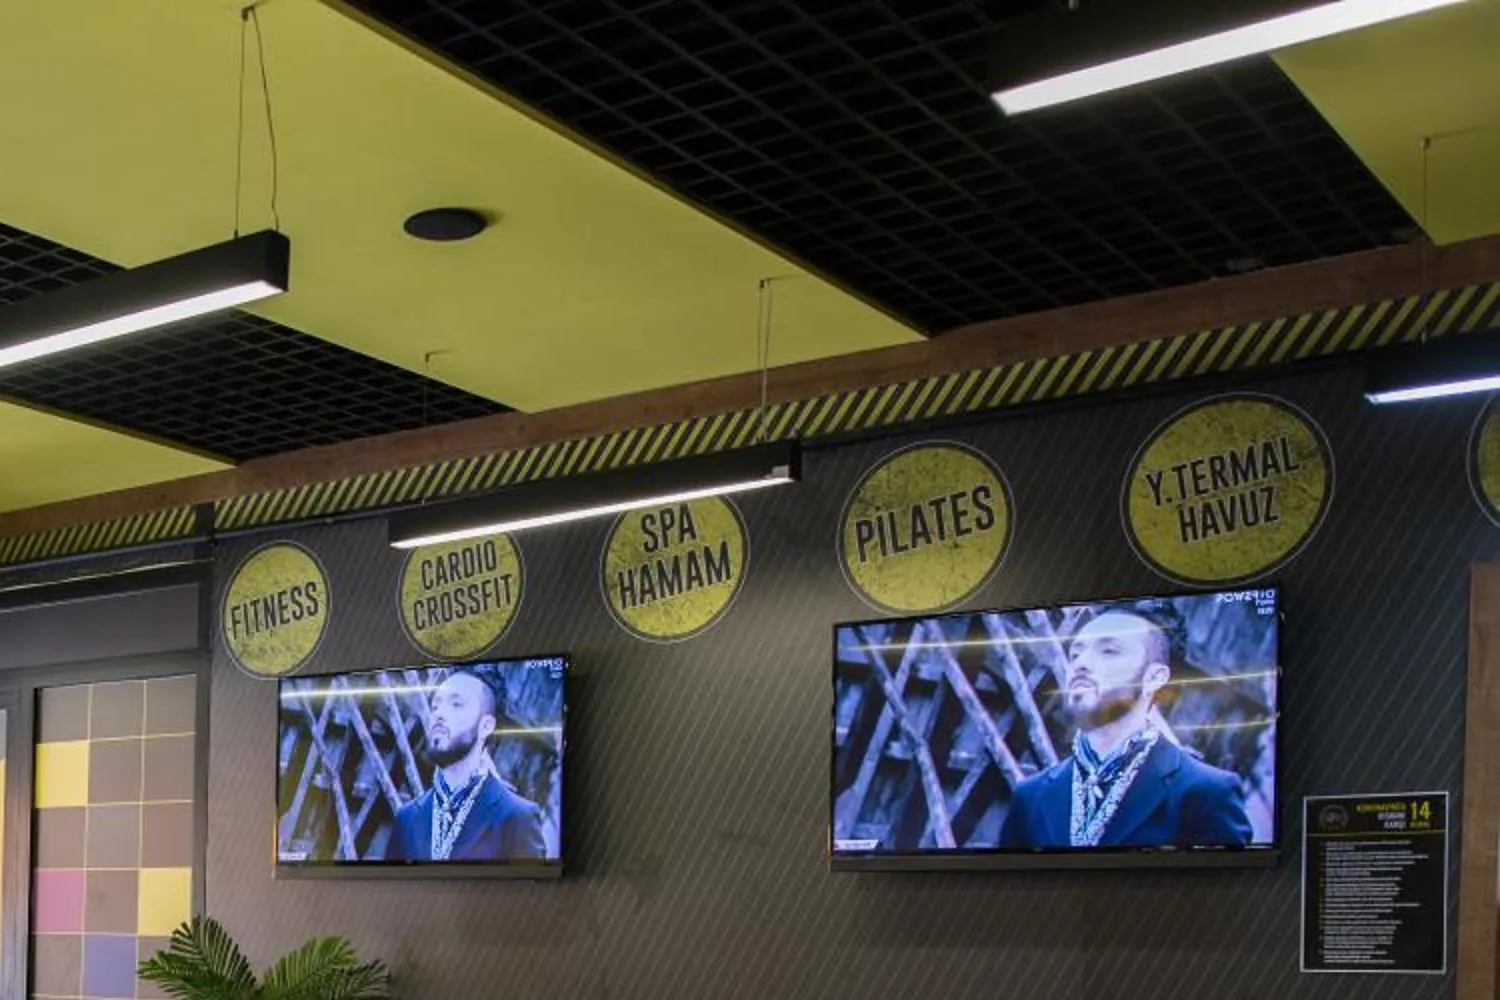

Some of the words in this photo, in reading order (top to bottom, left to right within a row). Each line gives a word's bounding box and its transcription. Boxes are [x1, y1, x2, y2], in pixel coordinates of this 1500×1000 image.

[1146, 437, 1300, 506] Y.TERMAL
[641, 503, 697, 552] SPA
[1179, 486, 1278, 542] HAVUZ
[421, 540, 496, 590] CARDIO
[618, 541, 731, 609] HAMAM
[231, 581, 318, 640] FITNESS
[414, 573, 512, 630] CROSSFIT
[1411, 801, 1432, 820] 14
